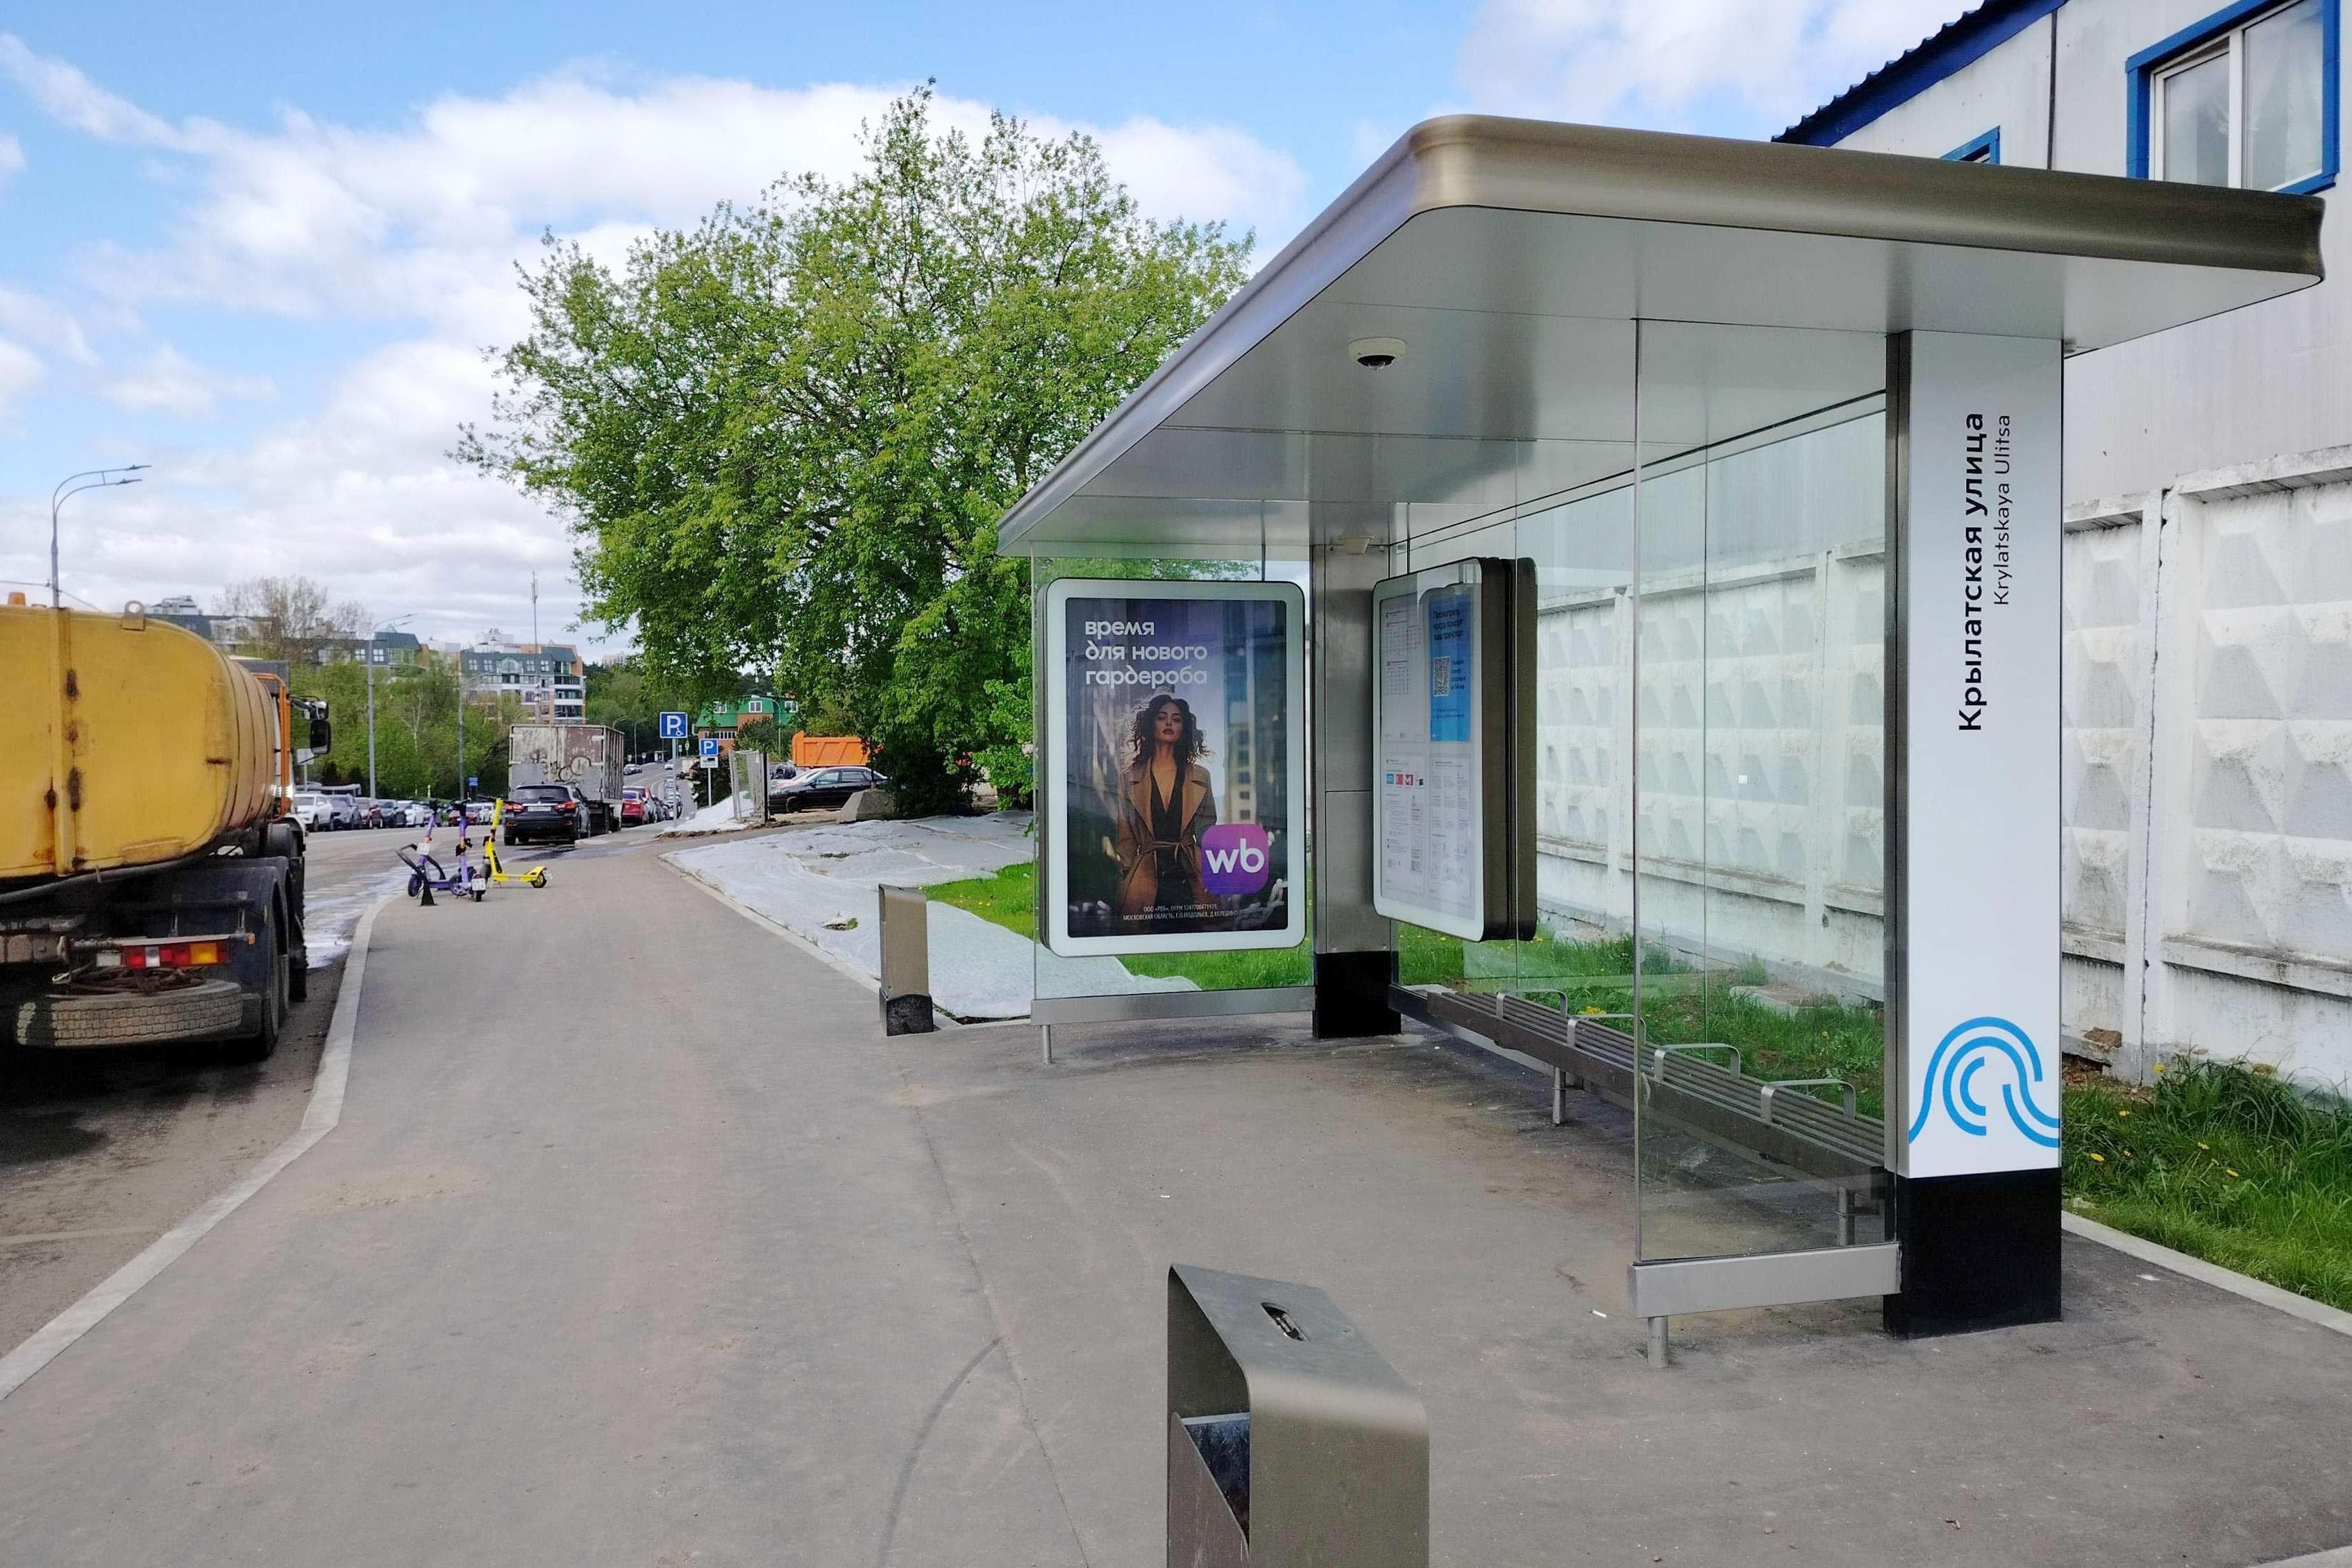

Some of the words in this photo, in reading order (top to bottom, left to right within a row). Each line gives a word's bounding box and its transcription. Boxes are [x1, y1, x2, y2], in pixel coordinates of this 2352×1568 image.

[1965, 413, 1988, 516] улица
[1994, 415, 2010, 474] Ulitsa
[1994, 483, 2013, 605] Krylatskaya
[1085, 621, 1154, 640] время
[1085, 640, 1125, 660] для
[1132, 646, 1208, 660] нового
[1958, 526, 1988, 730] Крылатская
[1086, 664, 1207, 689] гардероба
[1204, 838, 1265, 873] wb
